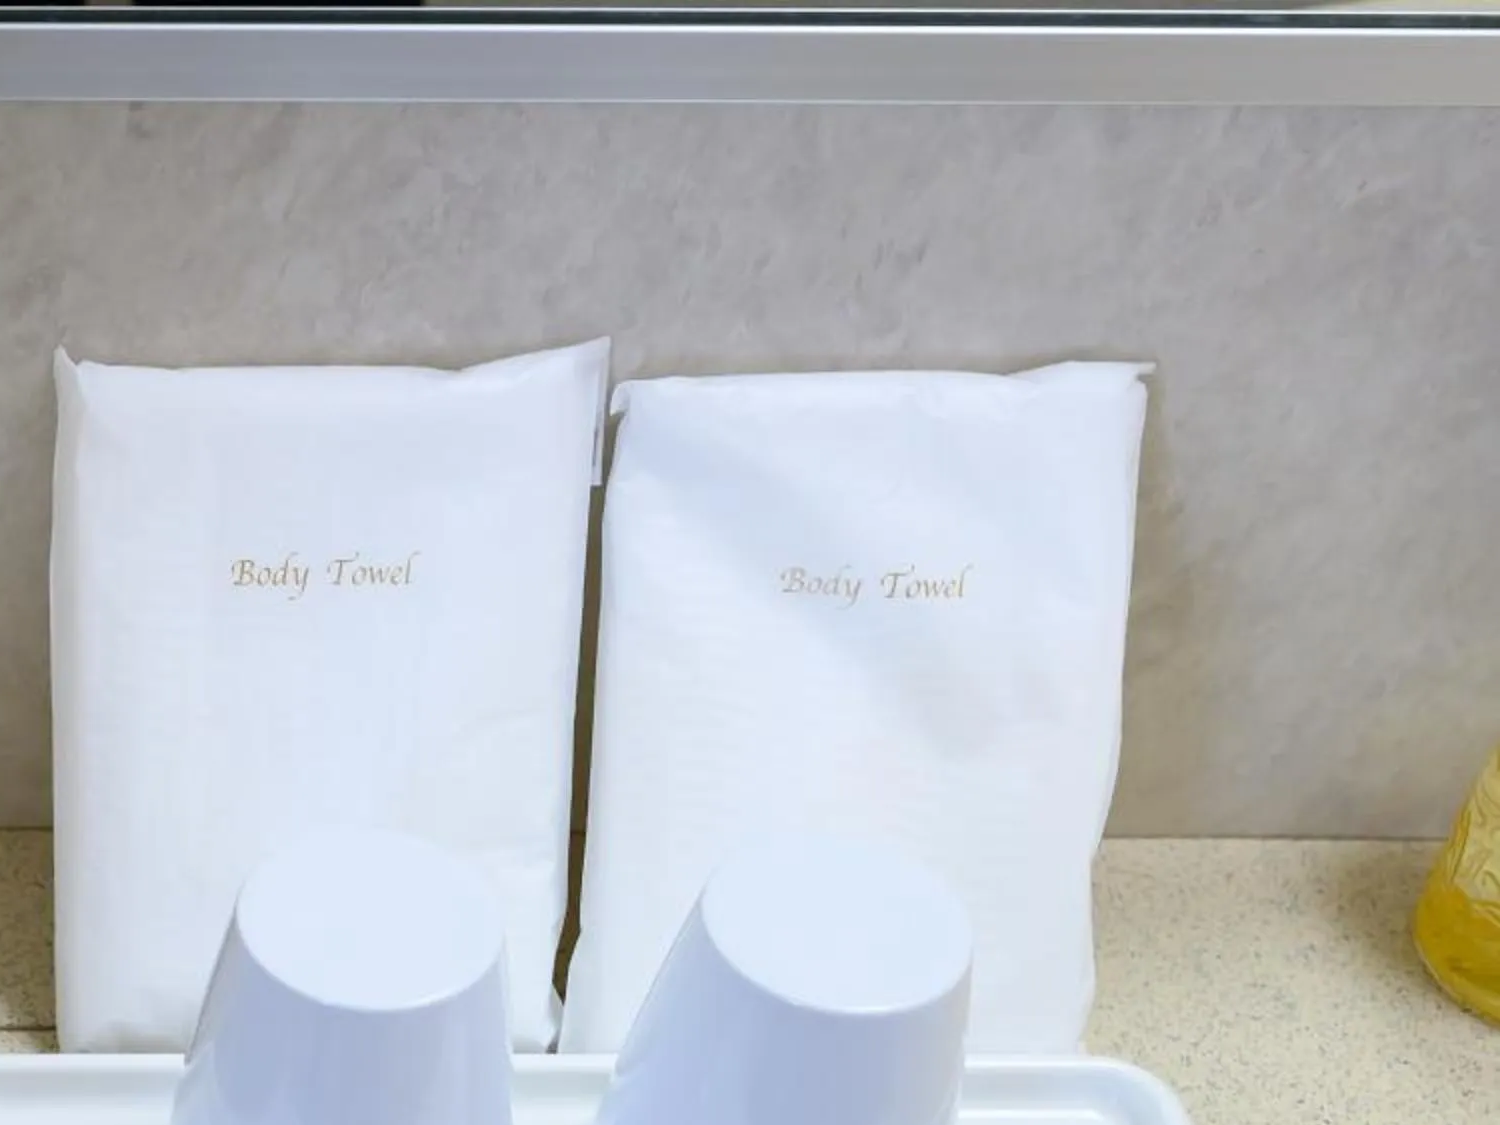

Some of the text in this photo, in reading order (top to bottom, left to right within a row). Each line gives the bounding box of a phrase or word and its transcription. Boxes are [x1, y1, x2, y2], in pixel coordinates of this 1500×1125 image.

[231, 551, 421, 601] Body Towel
[780, 565, 973, 609] Body Towel
